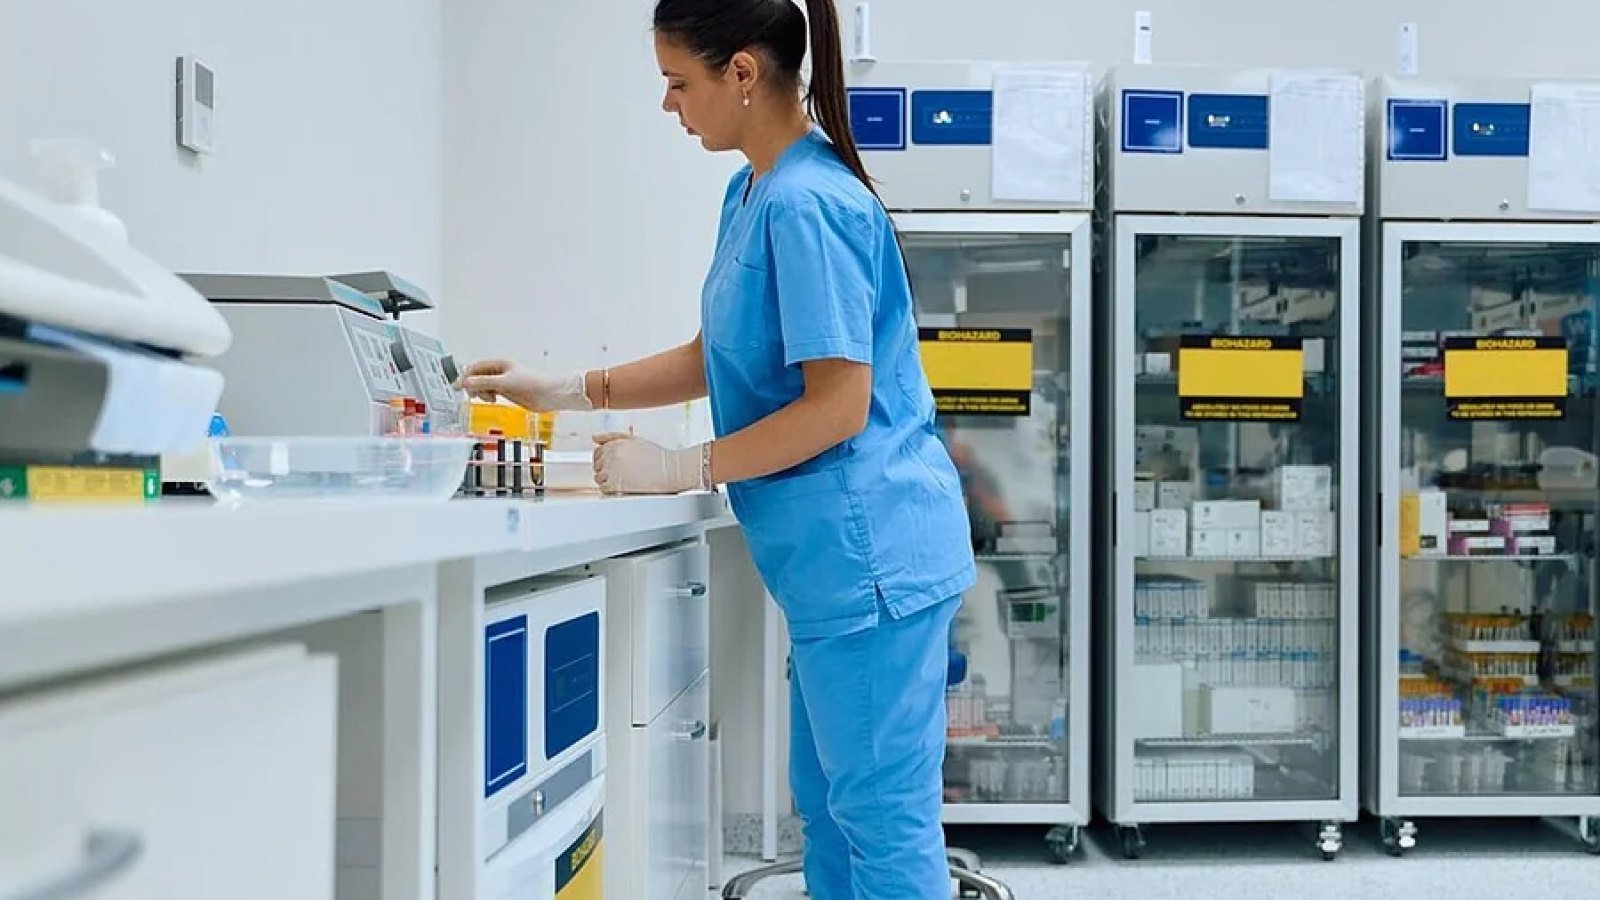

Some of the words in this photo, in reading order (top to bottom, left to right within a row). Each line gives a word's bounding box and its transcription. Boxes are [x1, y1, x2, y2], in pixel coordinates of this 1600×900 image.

[938, 330, 1001, 341] BIOHAZARD
[1210, 338, 1272, 348] BIOHAZARD
[1476, 339, 1536, 349] BIOHAZARD
